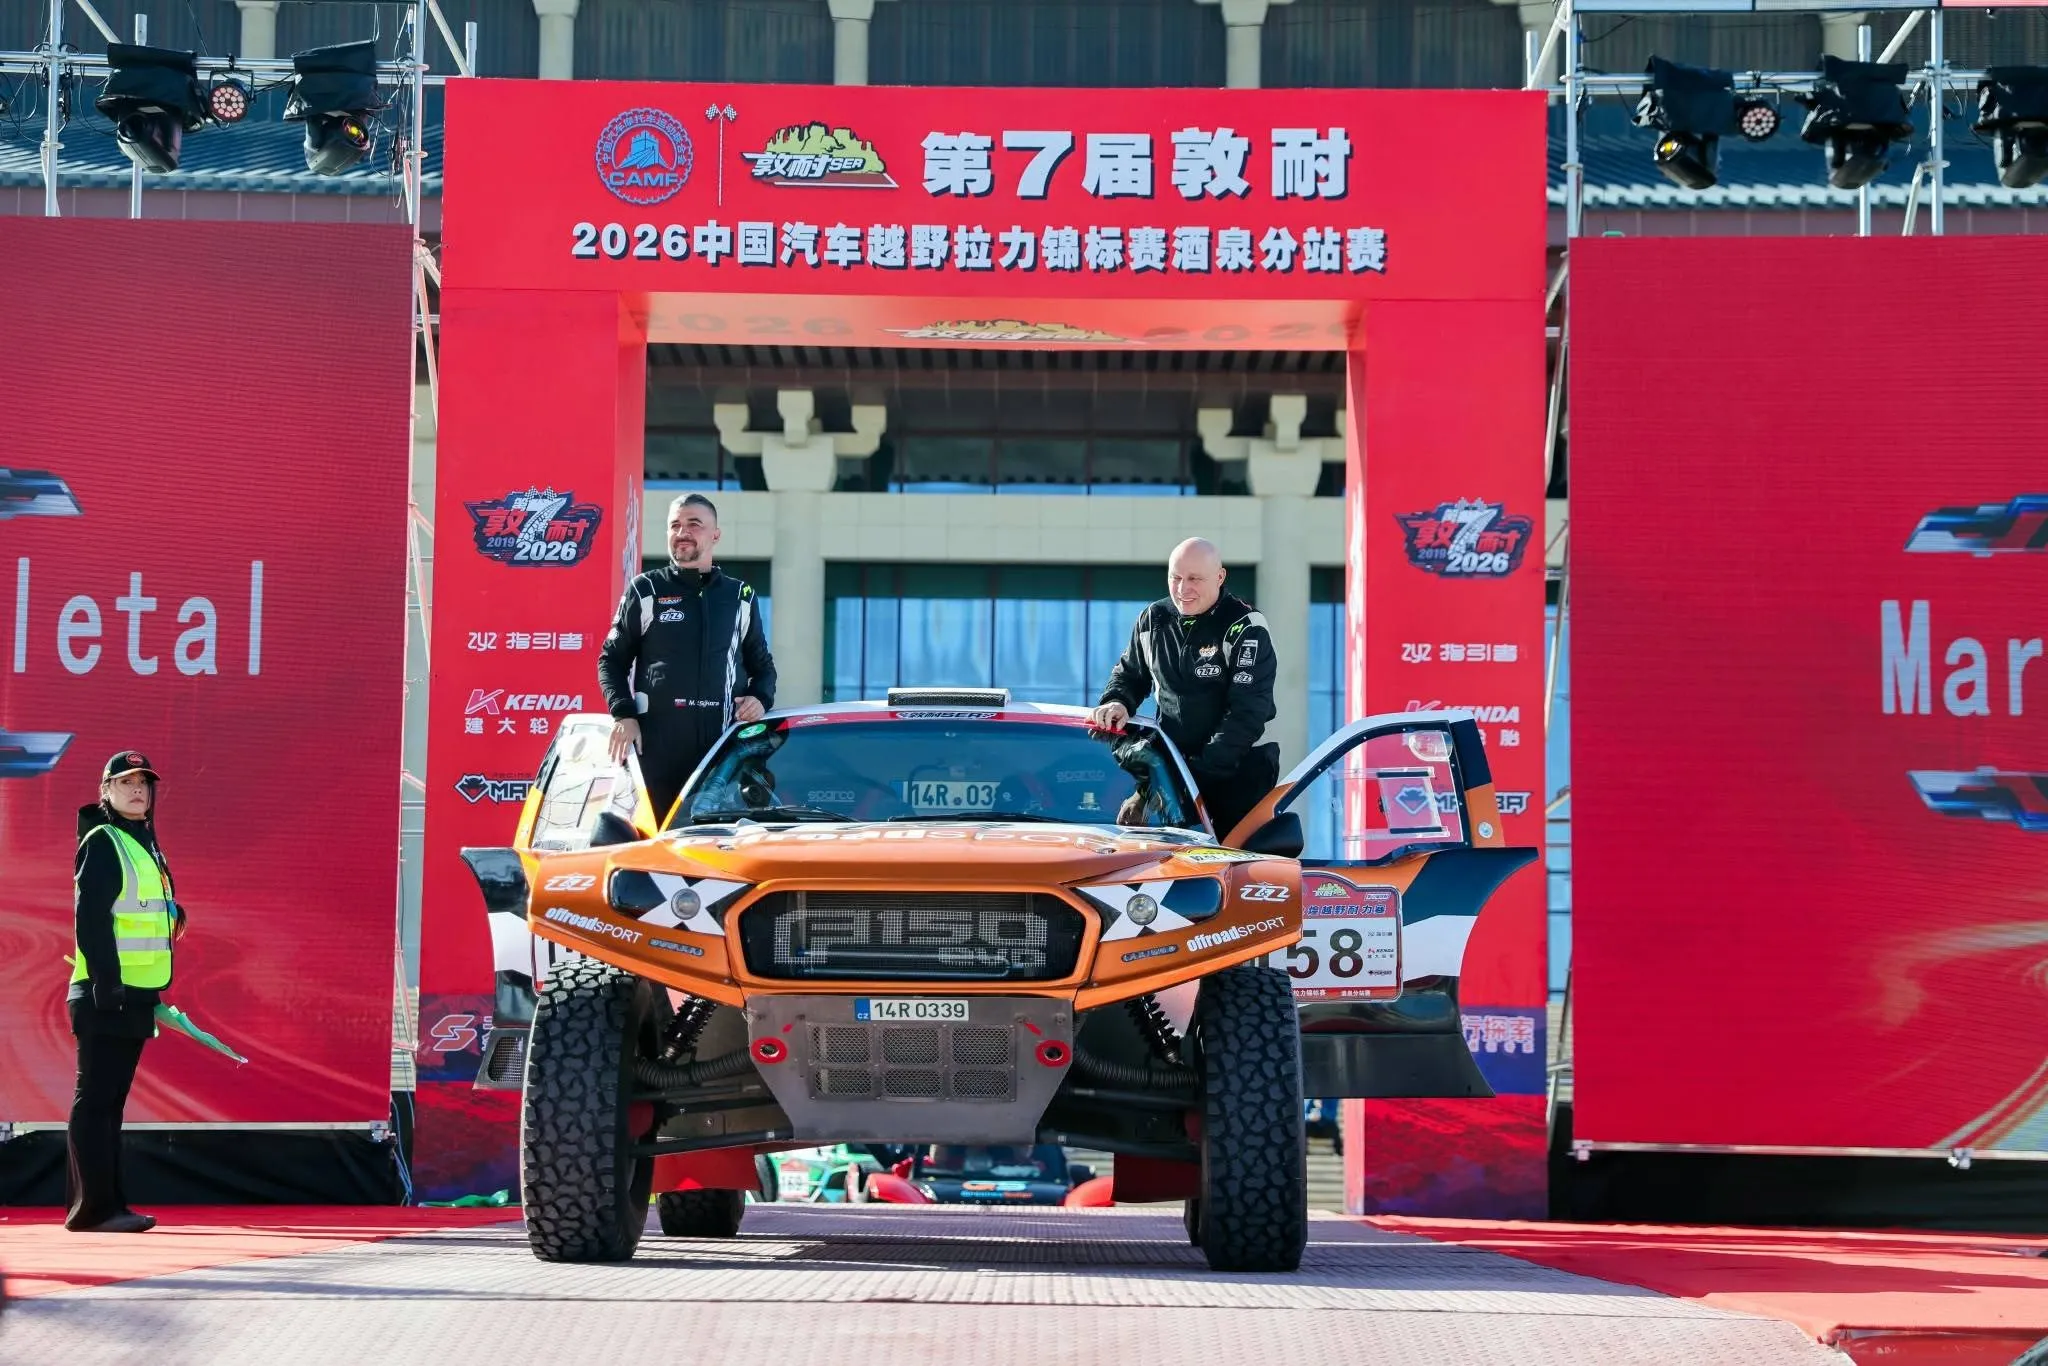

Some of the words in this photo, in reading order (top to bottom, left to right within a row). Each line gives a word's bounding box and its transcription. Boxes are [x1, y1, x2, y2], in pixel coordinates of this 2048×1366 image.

[921, 126, 1352, 199] 第7届敦耐
[610, 172, 679, 187] CAMF
[571, 219, 1388, 273] 2026中国汽车越野拉力锦标赛酒泉分站赛
[486, 537, 516, 548] 2019
[513, 541, 578, 561] 2026
[1445, 552, 1510, 573] 2026
[13, 556, 264, 676] letal
[506, 632, 583, 650] 指引者
[1440, 643, 1518, 662] 指引者
[1880, 600, 2043, 716] Mar
[503, 694, 583, 710] KENDA
[464, 717, 549, 734] 建大轮
[1186, 916, 1286, 952] offroadSPORT
[874, 1002, 911, 1018] 14R
[915, 1002, 966, 1018] 0339
